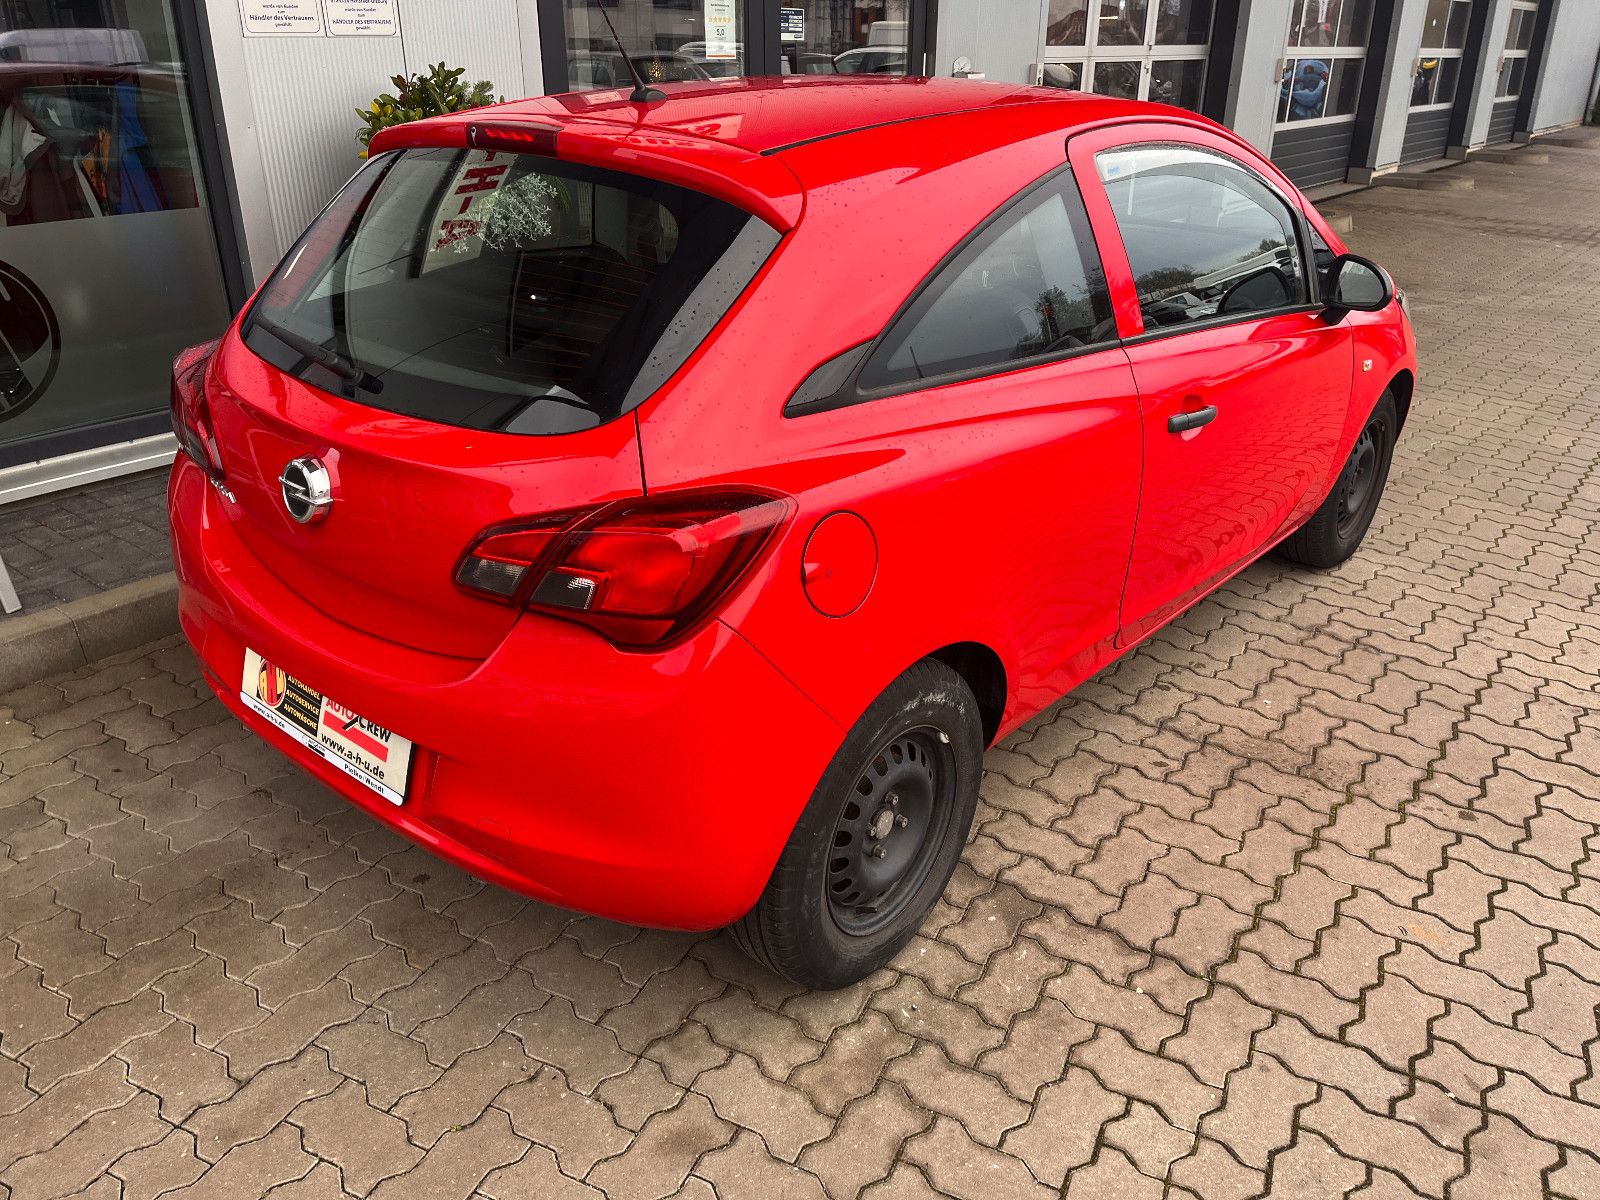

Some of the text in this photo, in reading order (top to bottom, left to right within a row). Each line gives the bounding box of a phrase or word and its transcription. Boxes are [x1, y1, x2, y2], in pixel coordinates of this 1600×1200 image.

[716, 28, 725, 37] 5,0
[287, 675, 321, 700] AUTOHANDEL
[285, 689, 320, 715] AUTOSERVICE
[283, 703, 317, 730] AUTOWÄSCHE
[321, 733, 385, 780] www.a-h-u.de
